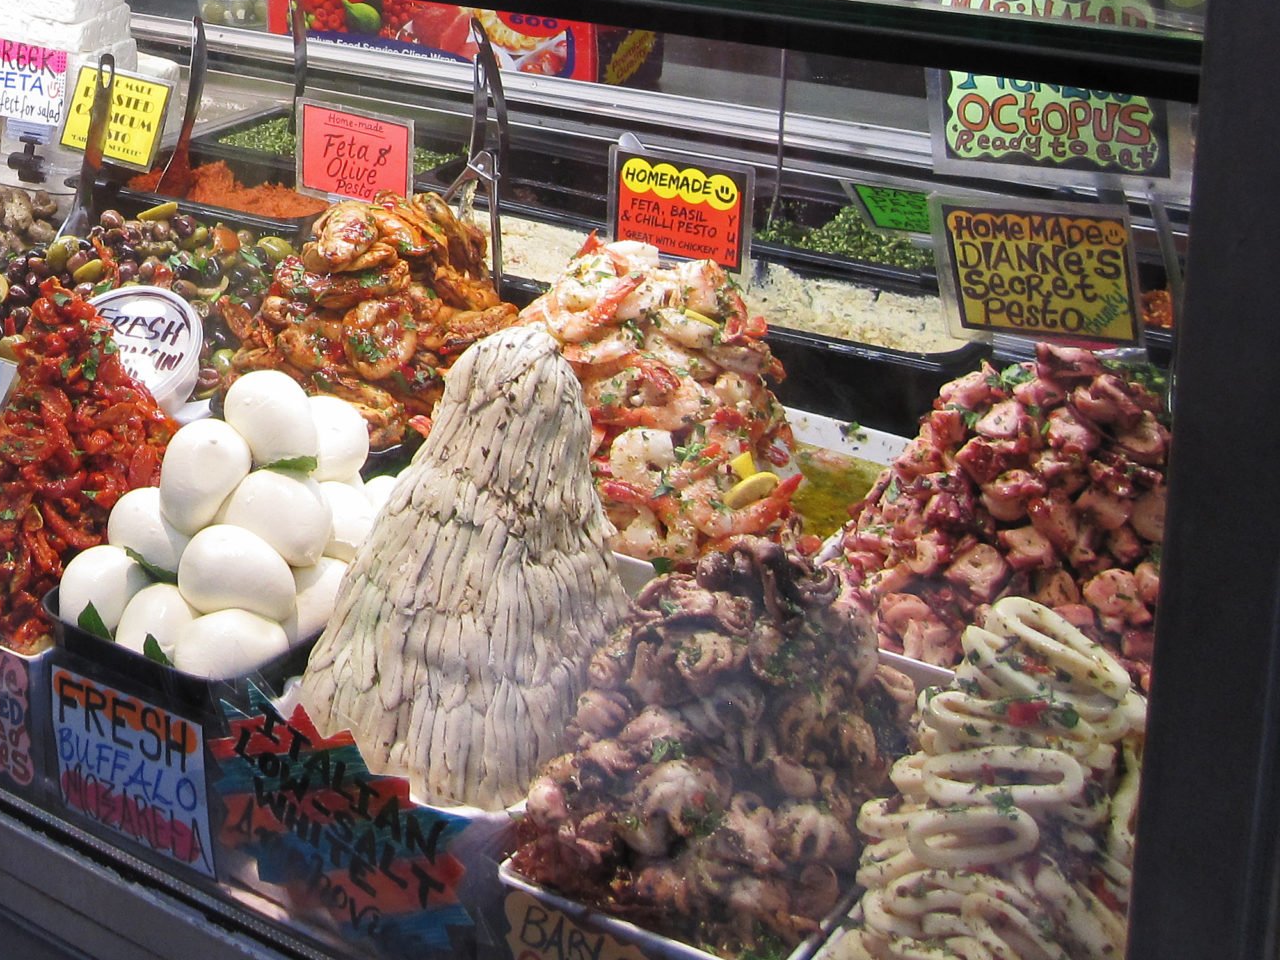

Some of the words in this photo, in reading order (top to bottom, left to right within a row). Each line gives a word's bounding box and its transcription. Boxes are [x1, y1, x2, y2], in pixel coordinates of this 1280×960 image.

[508, 13, 558, 29] 600
[20, 94, 36, 119] for
[328, 112, 384, 133] Home-made
[323, 133, 370, 162] Feta
[1048, 135, 1089, 159] to
[326, 157, 377, 185] Olive
[625, 166, 713, 195] HOMEMADE
[335, 178, 375, 199] Pesto
[620, 209, 631, 222] &
[635, 212, 674, 231] CHILLI
[677, 220, 718, 239] PESTO
[670, 205, 708, 223] BASIL
[655, 234, 677, 248] WITH
[58, 675, 188, 774] FRESH
[57, 726, 198, 813] BUFFALO
[257, 702, 450, 865] ITALIAN
[253, 775, 376, 898] WHITE
